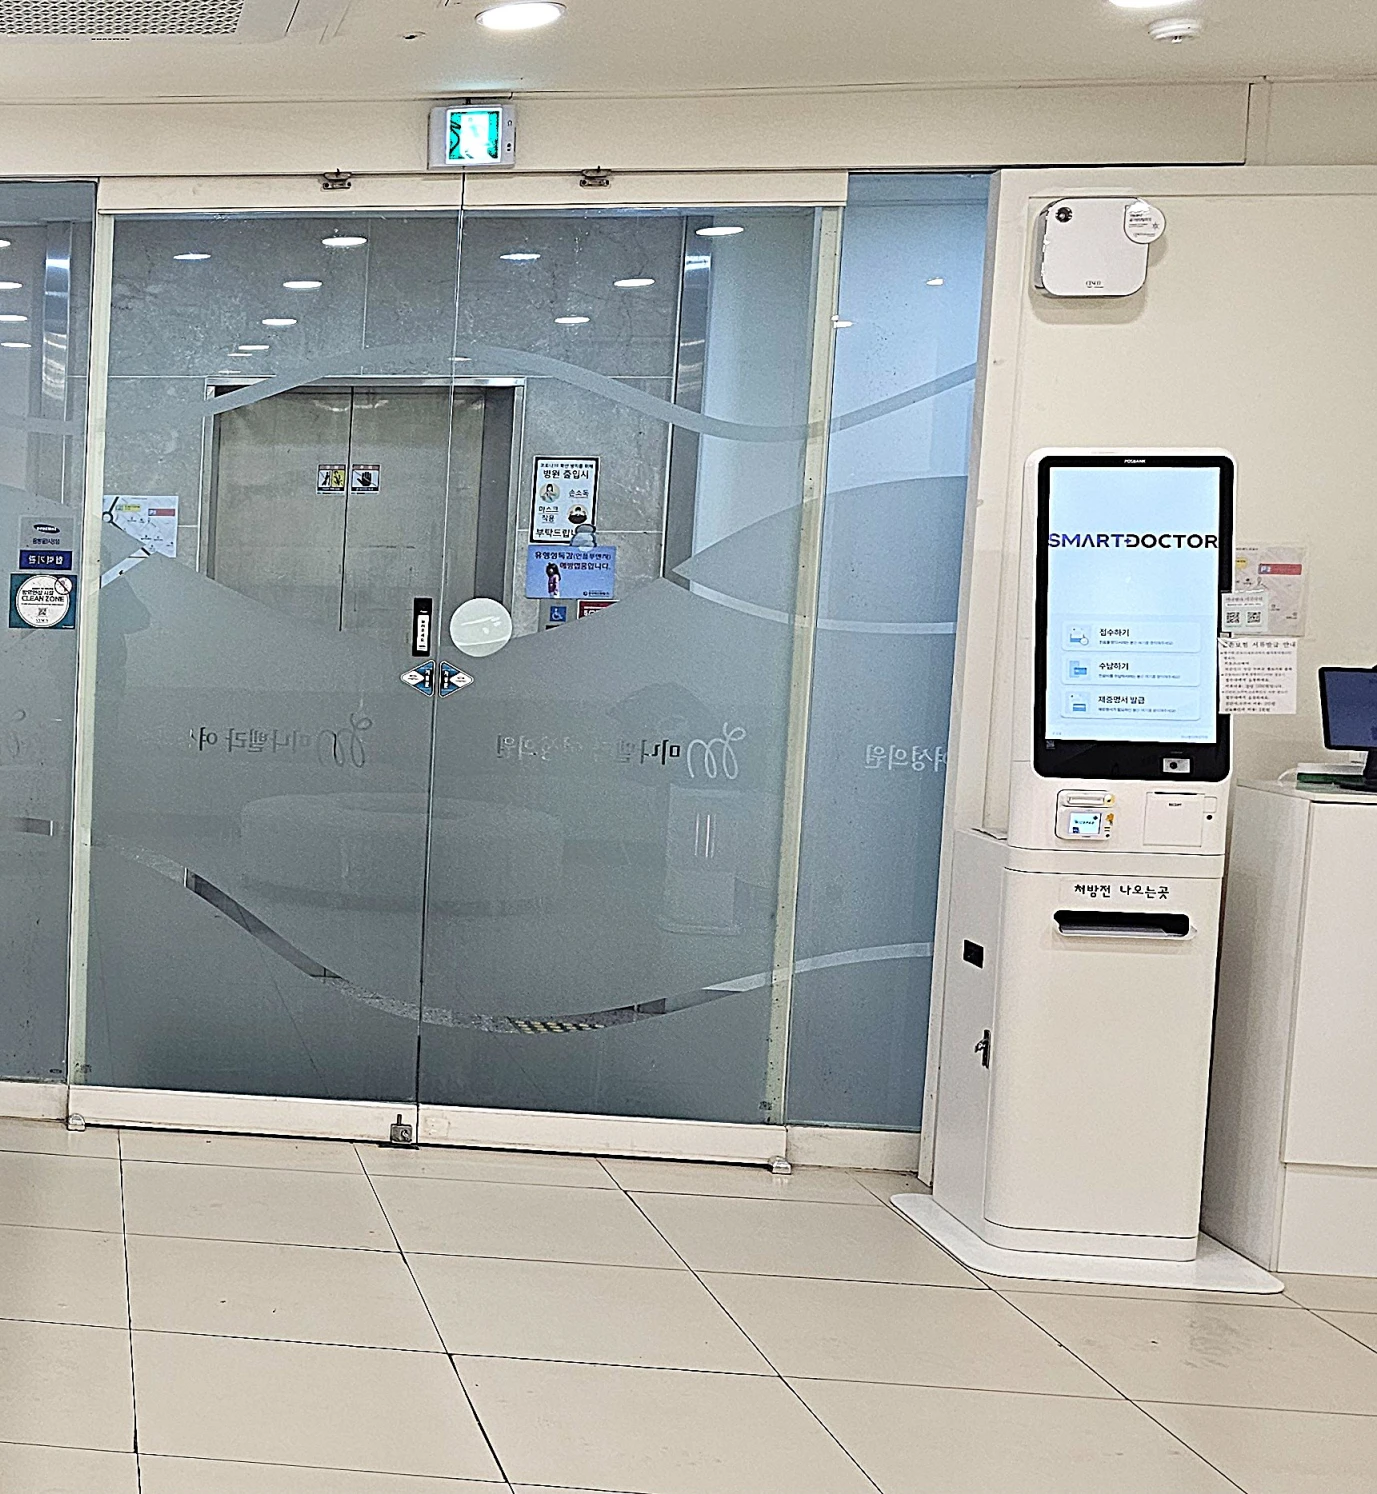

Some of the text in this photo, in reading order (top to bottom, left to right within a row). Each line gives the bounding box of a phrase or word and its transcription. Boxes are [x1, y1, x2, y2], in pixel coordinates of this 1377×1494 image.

[543, 469, 589, 479] 병원 출입시
[568, 489, 589, 498] 손소독
[538, 505, 559, 513] 마스크
[542, 514, 555, 522] 착용
[1099, 628, 1130, 637] 접수하기
[1098, 662, 1129, 671] 수납하기
[1097, 695, 1146, 705] 제증명서 발급
[1074, 884, 1170, 899] 처방전 나오는곳
